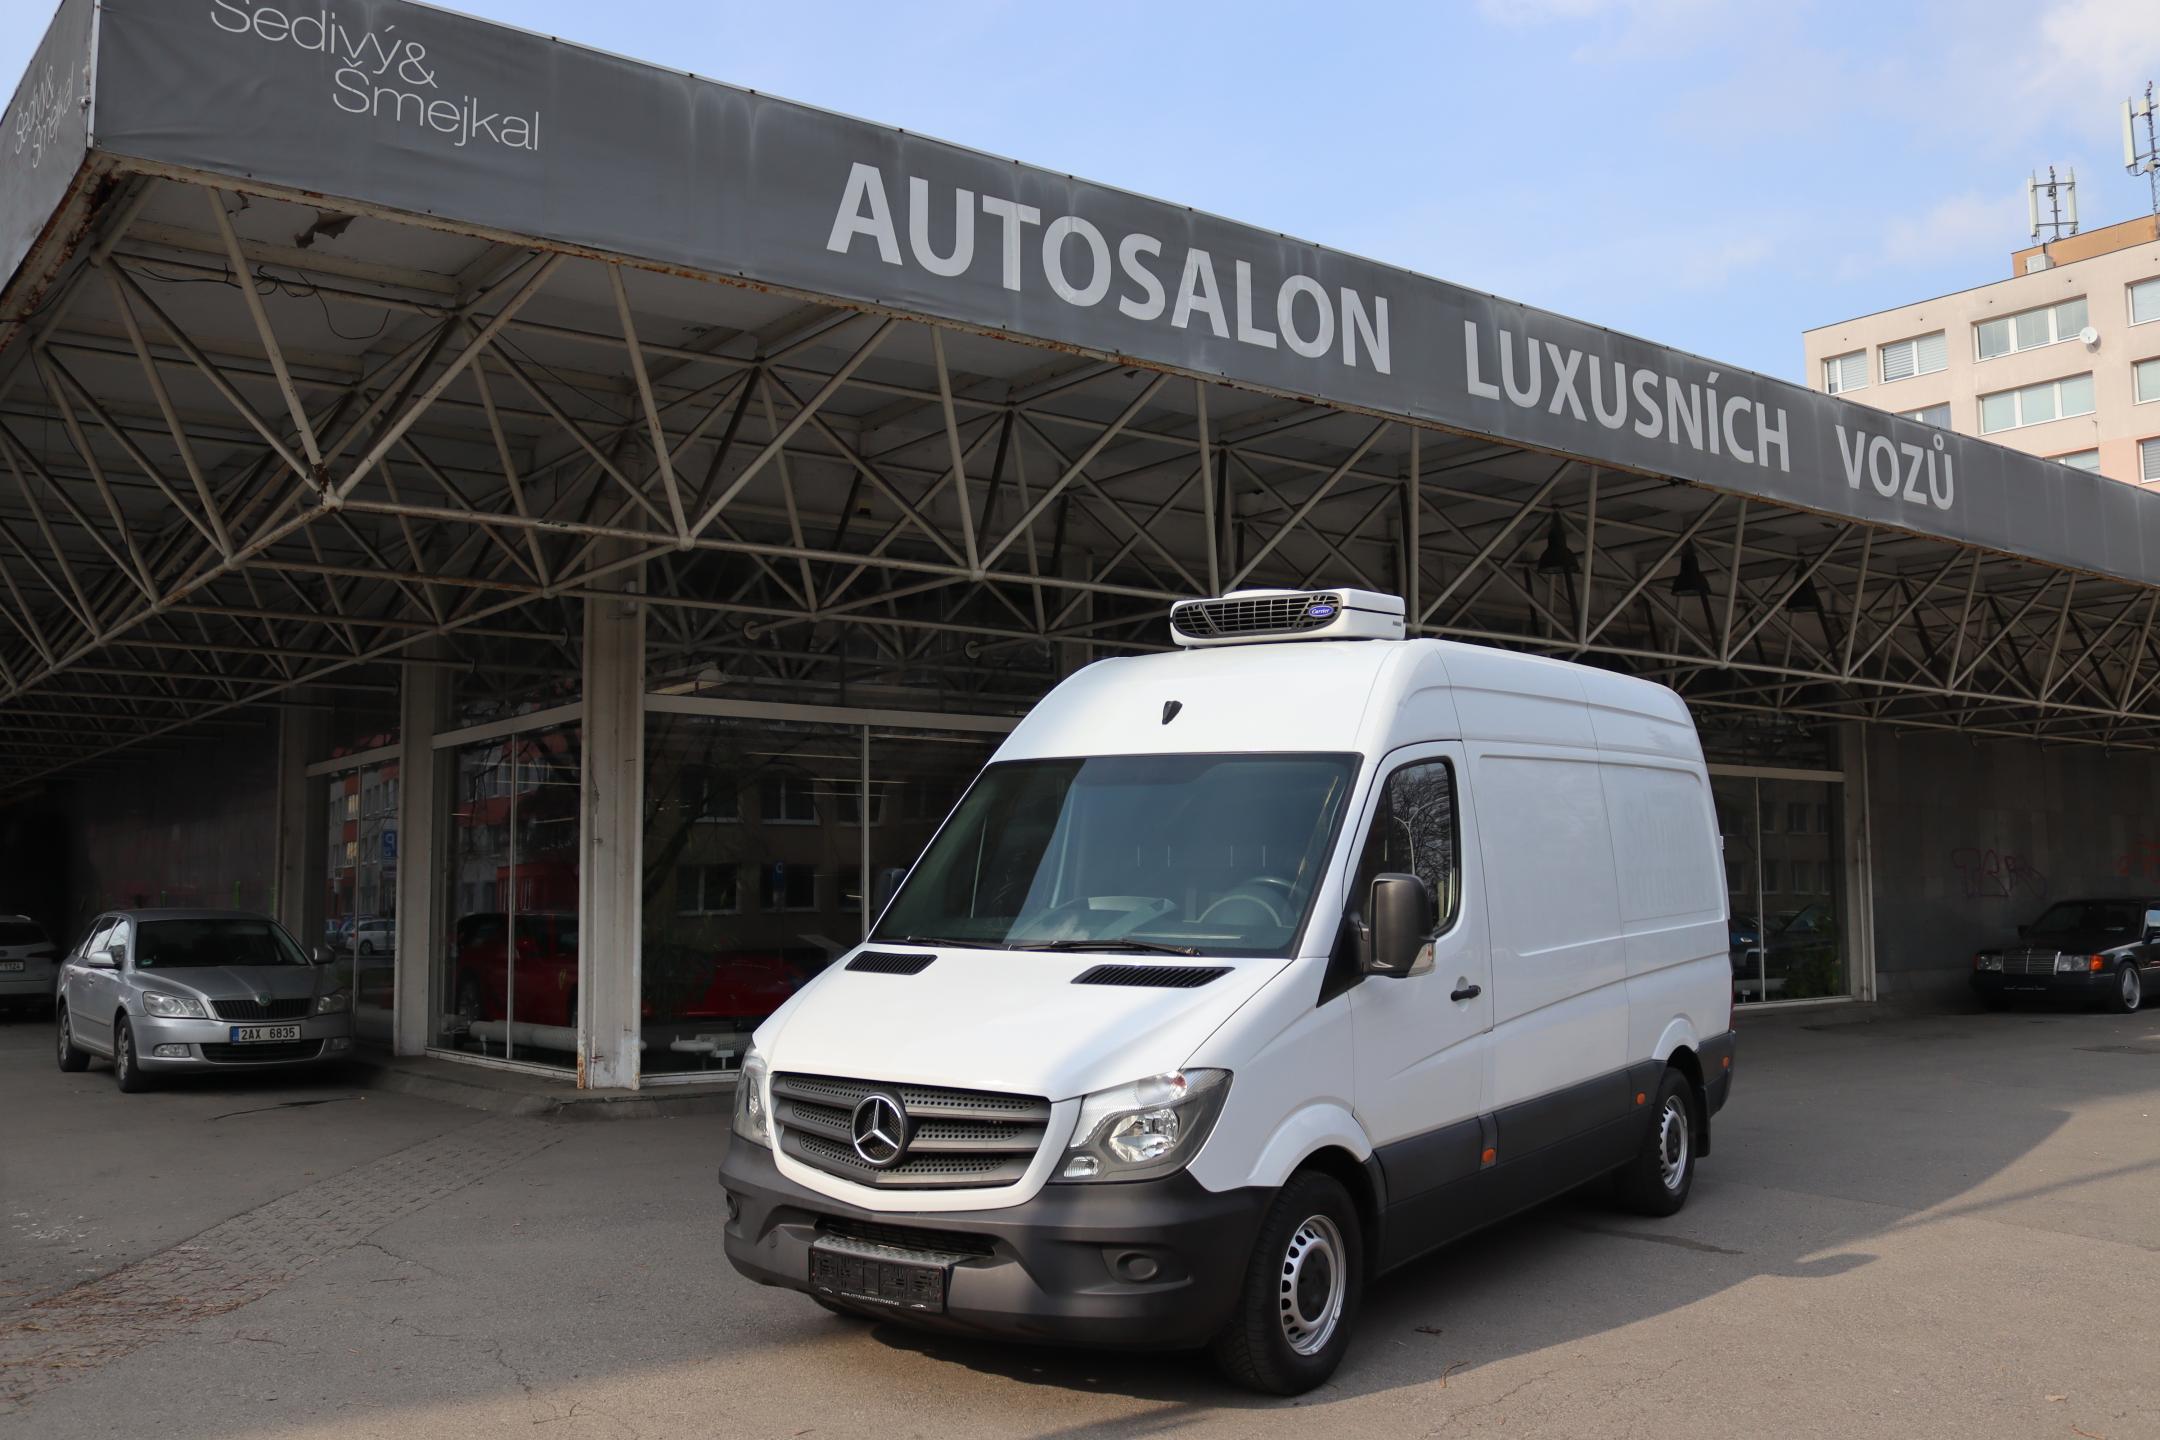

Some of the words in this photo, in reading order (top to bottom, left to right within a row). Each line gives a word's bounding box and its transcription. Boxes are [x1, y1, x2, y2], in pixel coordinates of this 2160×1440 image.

[332, 56, 540, 151] Šmejkal
[826, 162, 1391, 375] AUTOSALON
[1464, 320, 1790, 473] LUXUSNÍCH
[1834, 424, 1954, 511] VOZŮ
[241, 1029, 261, 1041] 2AX
[269, 1027, 296, 1039] 6835
